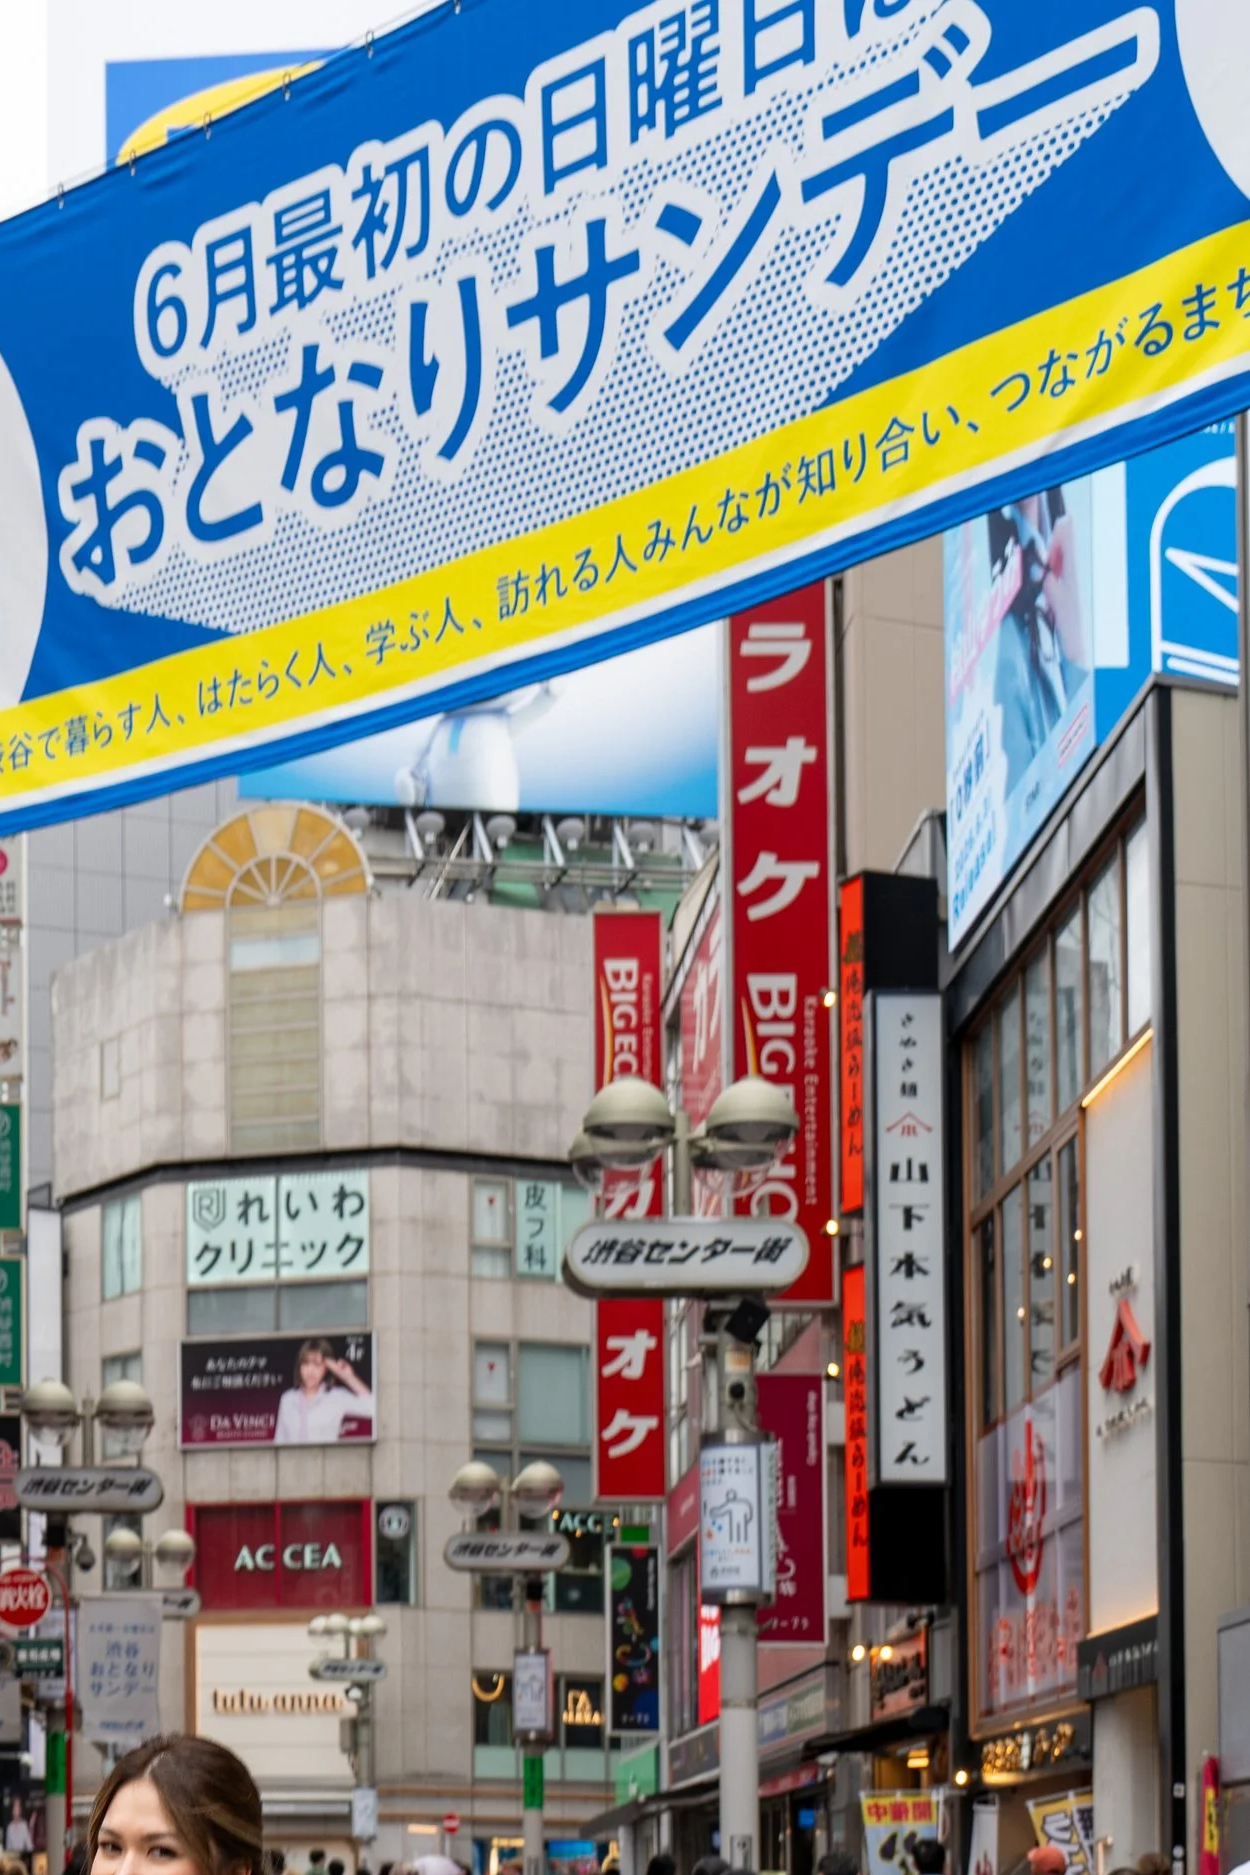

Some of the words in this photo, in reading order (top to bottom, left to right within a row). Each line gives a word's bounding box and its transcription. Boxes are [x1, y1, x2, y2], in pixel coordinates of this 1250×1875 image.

[71, 24, 1139, 587] おとなりサンデー
[602, 957, 640, 1029] BIG
[746, 973, 798, 1074] BIG
[803, 994, 819, 1070] Karaoke
[803, 1074, 820, 1205] Entertainment
[237, 1183, 365, 1226] れいわ
[523, 1183, 548, 1271] 皮フ科
[194, 1233, 365, 1277] クリニック
[580, 1235, 794, 1269] 渋谷センター街
[889, 1157, 933, 1467] 山下本気うどん
[210, 1415, 231, 1430] DA
[232, 1414, 275, 1430] VINCI
[21, 1476, 152, 1497] 渋谷センター街
[234, 1543, 343, 1572] ACCEA
